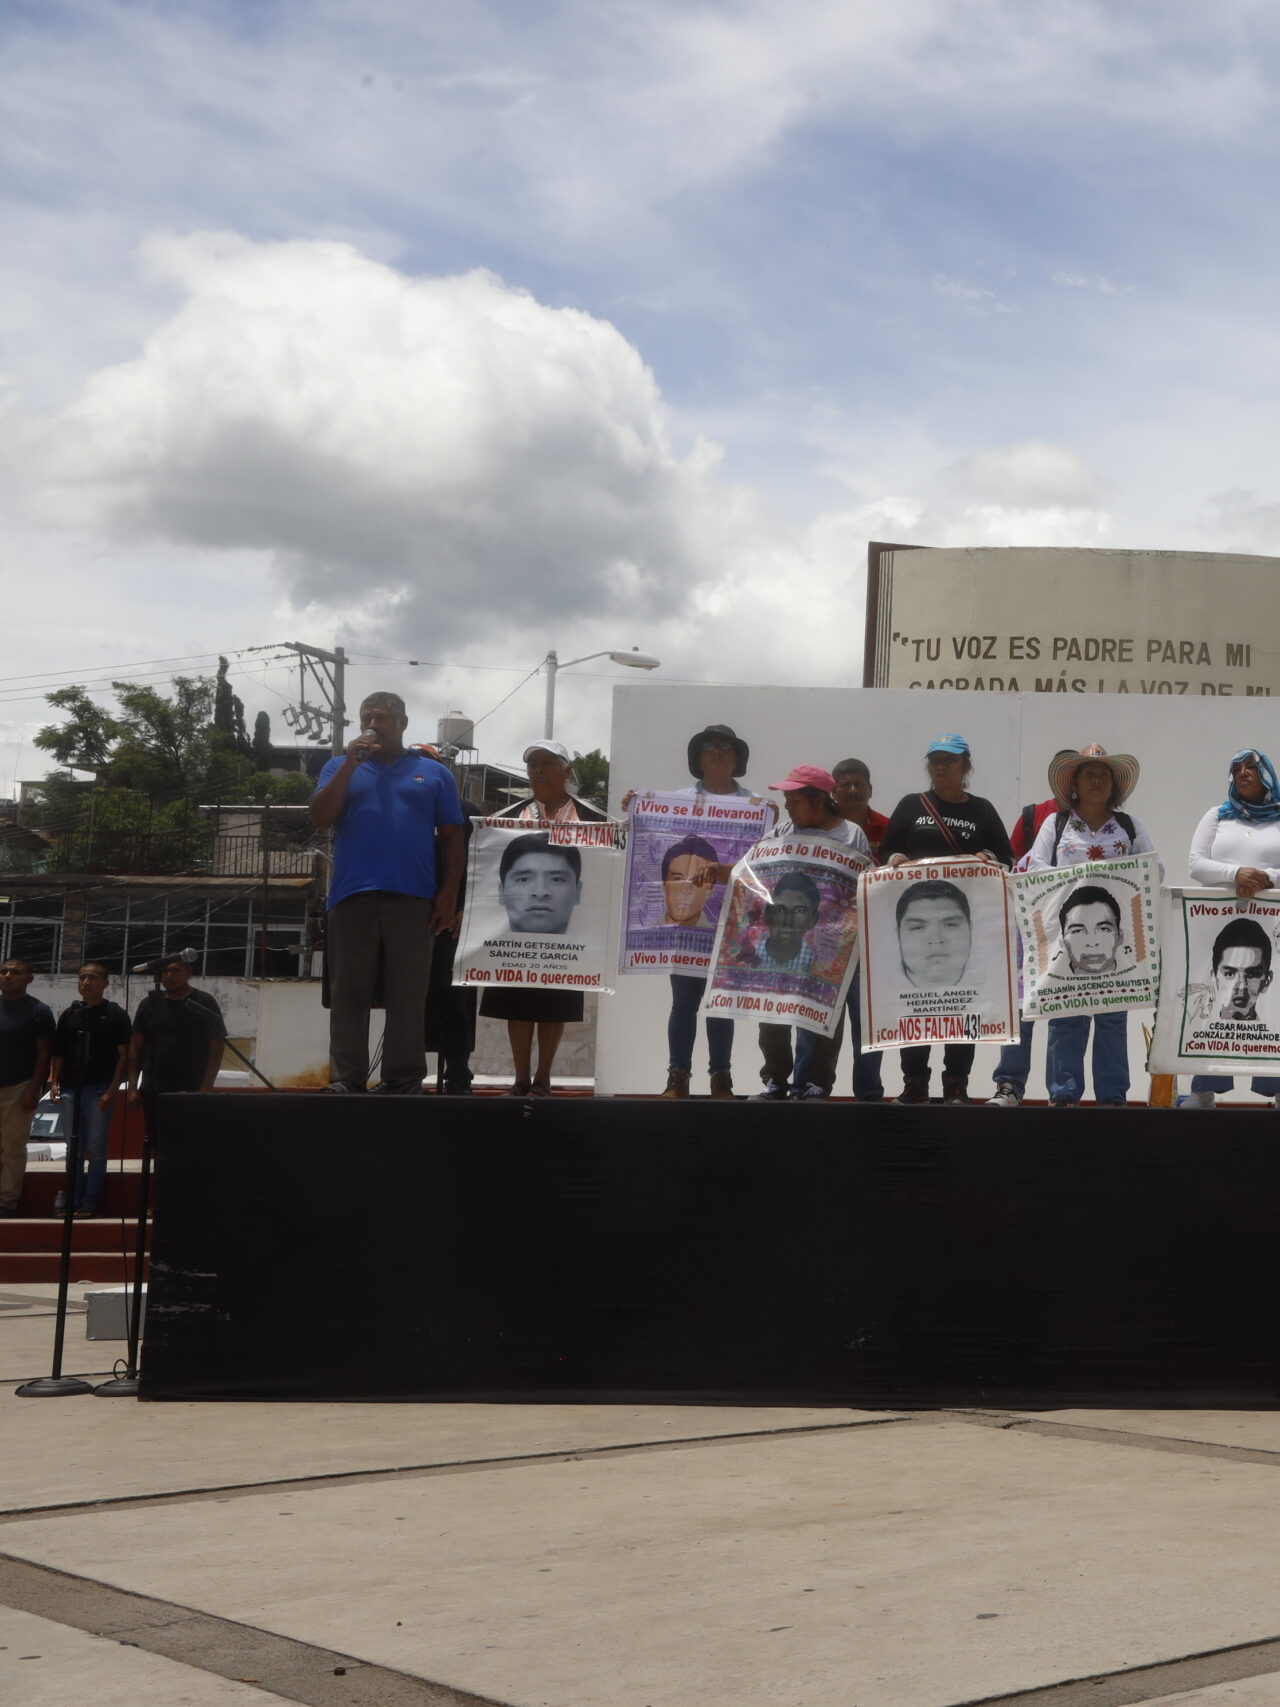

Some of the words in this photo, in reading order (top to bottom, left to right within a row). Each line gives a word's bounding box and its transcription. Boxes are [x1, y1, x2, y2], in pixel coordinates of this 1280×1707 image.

[952, 636, 998, 660] VOZ
[1009, 636, 1041, 661] ES
[1053, 637, 1134, 663] PADRE
[1146, 639, 1212, 666] PARA
[1226, 643, 1251, 668] MI
[636, 800, 669, 814] ¡Vivo
[673, 805, 688, 815] se
[692, 804, 704, 817] lo
[708, 805, 764, 820] llevaron!
[519, 820, 532, 829] se
[551, 826, 573, 844] NOS
[577, 826, 614, 846] FALTAN
[751, 847, 779, 860] ¡Vivo
[780, 844, 792, 854] se
[796, 843, 808, 856] lo
[812, 845, 866, 872] llevaron!
[908, 870, 921, 880] se
[926, 867, 938, 879] lo
[943, 866, 1000, 878] llevaron!
[1024, 874, 1054, 887] ¡Vivo
[1057, 871, 1070, 879] se
[1072, 866, 1083, 876] lo
[1086, 859, 1139, 872] llevaron!
[1222, 906, 1233, 915] se
[483, 940, 521, 949] MARTÍN
[524, 942, 586, 951] GETSEMANY
[540, 953, 578, 961] GARCÍA
[630, 952, 656, 967] ¡Vivo
[659, 952, 668, 964] lo
[465, 968, 491, 982] ¡Con
[495, 969, 523, 983] VIDA
[527, 970, 537, 983] lo
[541, 973, 600, 986] queremos!
[1038, 984, 1075, 996] BENJAMÍN
[1077, 981, 1114, 991] ASCENCIO
[1116, 978, 1151, 987] BAUTISTA
[710, 995, 732, 1008] ¡Con
[736, 996, 760, 1011] VIDA
[763, 998, 773, 1012] lo
[776, 1001, 828, 1024] queremos!
[1039, 1002, 1062, 1014] ¡Con
[1063, 998, 1088, 1009] VIDA
[1090, 997, 1100, 1006] lo
[1102, 992, 1151, 1006] queremos!
[900, 1018, 921, 1041] NOS
[925, 1017, 964, 1040] FALTAN
[1193, 1031, 1235, 1039] GONZÁLEZ
[1209, 1022, 1235, 1030] CÉSAR
[1236, 1024, 1269, 1032] MANUEL
[1185, 1040, 1205, 1052] ¡Con
[1207, 1041, 1230, 1051] VIDA
[1231, 1042, 1240, 1051] lo
